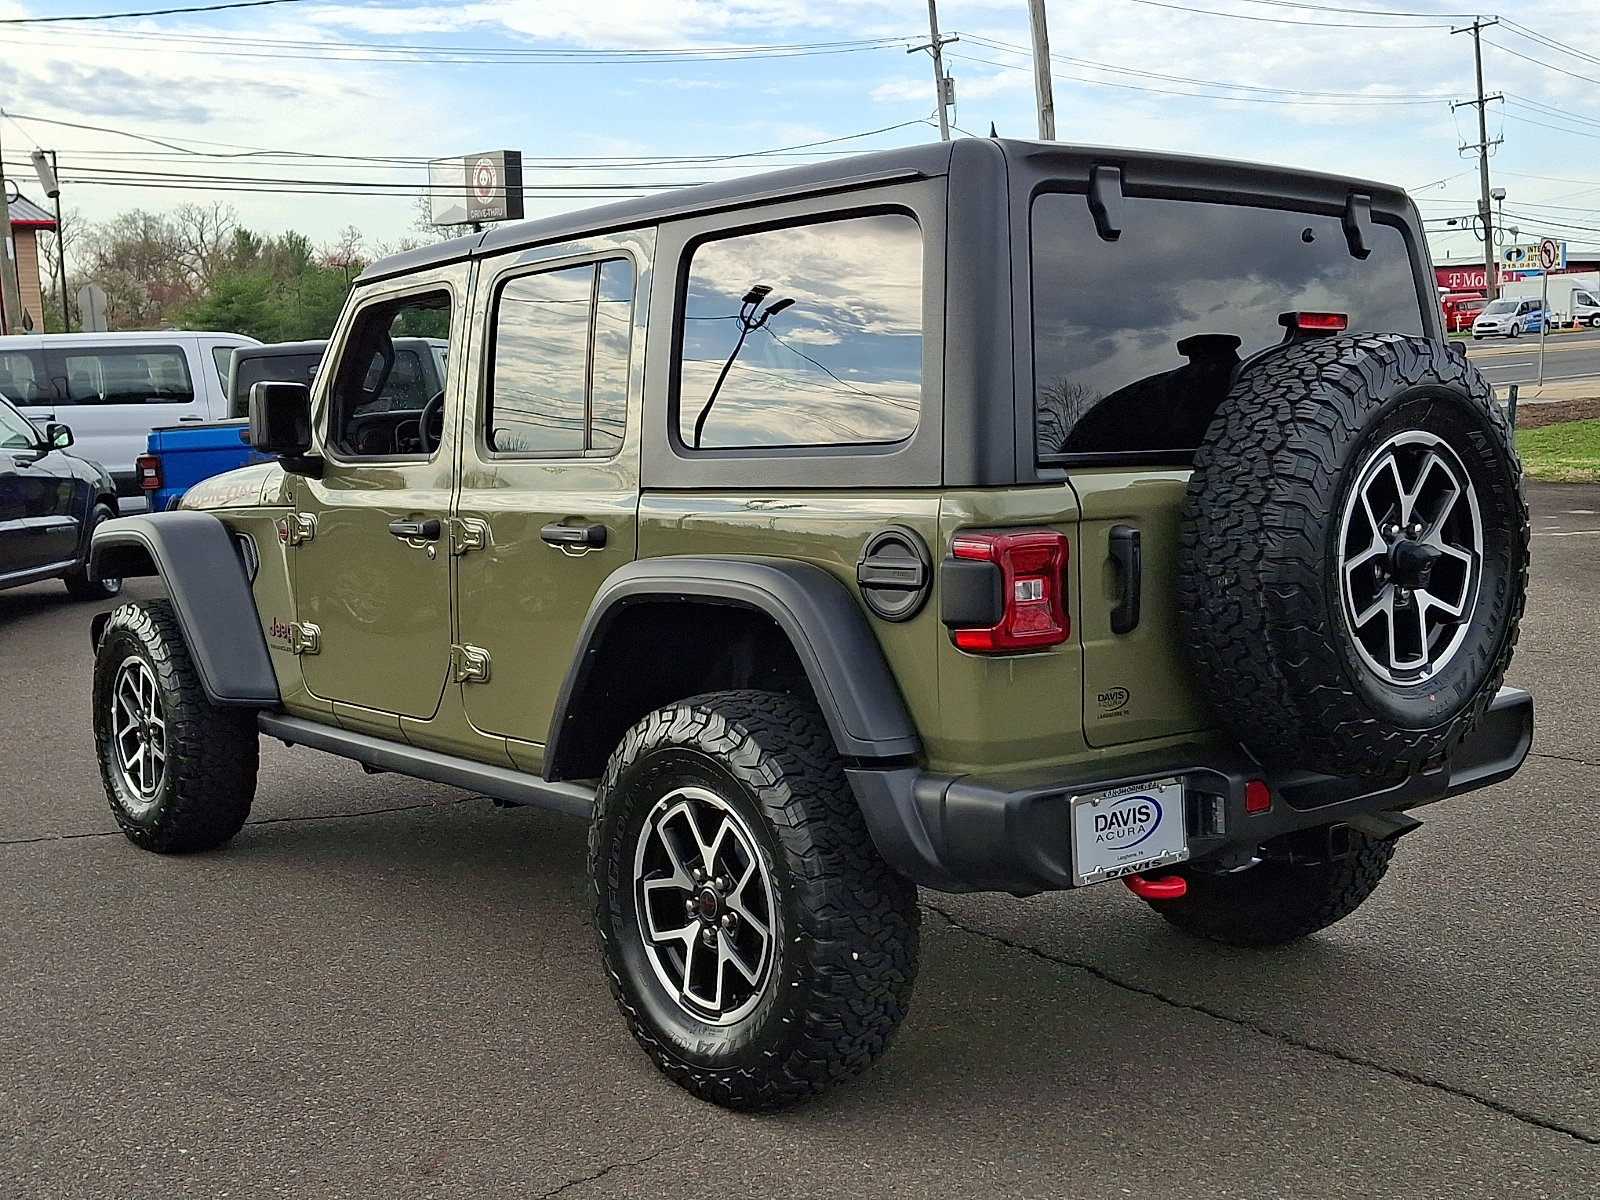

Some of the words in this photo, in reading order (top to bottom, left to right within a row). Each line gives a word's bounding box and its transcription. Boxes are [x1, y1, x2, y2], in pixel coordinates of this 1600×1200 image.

[470, 207, 503, 219] DRIVE-THRU
[1527, 245, 1560, 253] INTEY
[1097, 691, 1125, 702] DAVIS
[1094, 804, 1151, 833] DAVIS
[1095, 825, 1146, 844] ACURA
[1105, 859, 1163, 878] DAVIS
